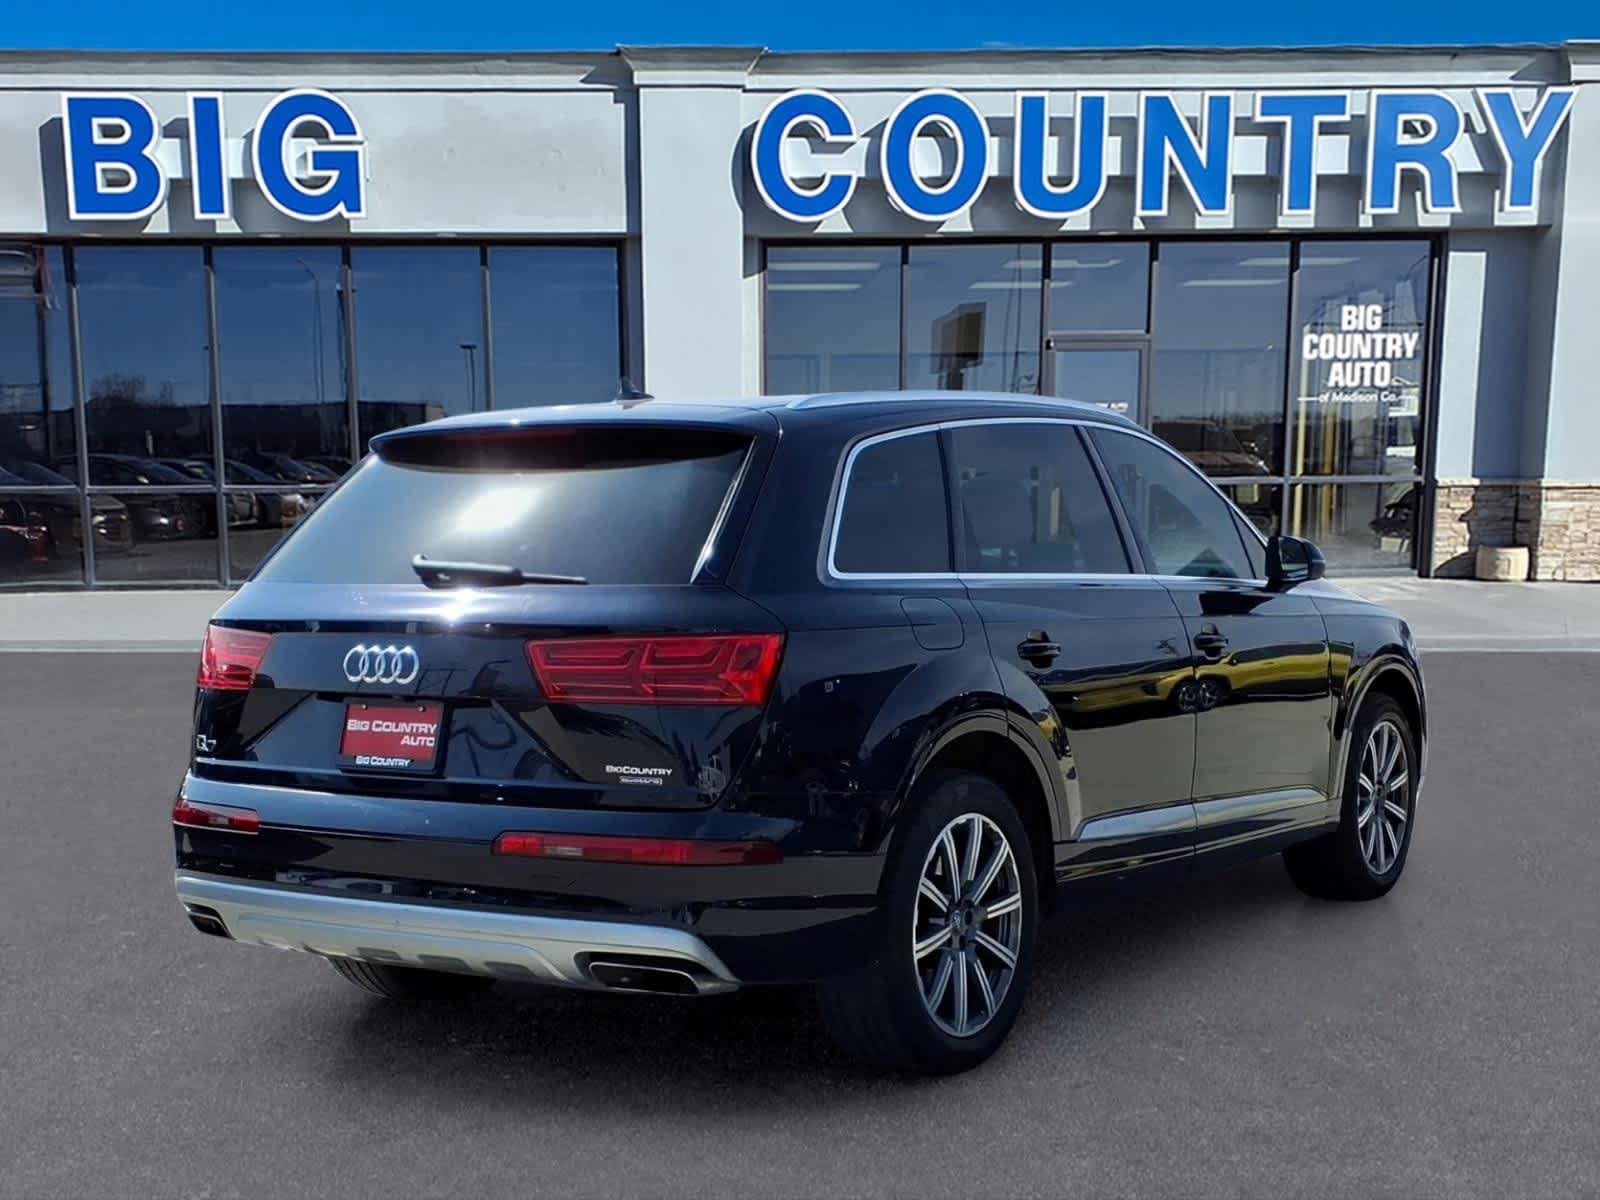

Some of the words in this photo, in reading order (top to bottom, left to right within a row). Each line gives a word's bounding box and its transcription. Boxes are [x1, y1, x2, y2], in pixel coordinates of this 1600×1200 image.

[61, 89, 368, 221] BIG
[750, 88, 1576, 222] COUNTRY
[1341, 304, 1382, 331] BIG
[1302, 332, 1419, 359] COUNTRY
[1327, 361, 1391, 387] AUTO
[346, 719, 370, 731] BIG
[371, 719, 437, 734] COUNTRY
[196, 734, 217, 752] Q7
[400, 735, 435, 747] AUTO
[355, 755, 370, 765] BIG
[370, 756, 411, 767] COUNTRY
